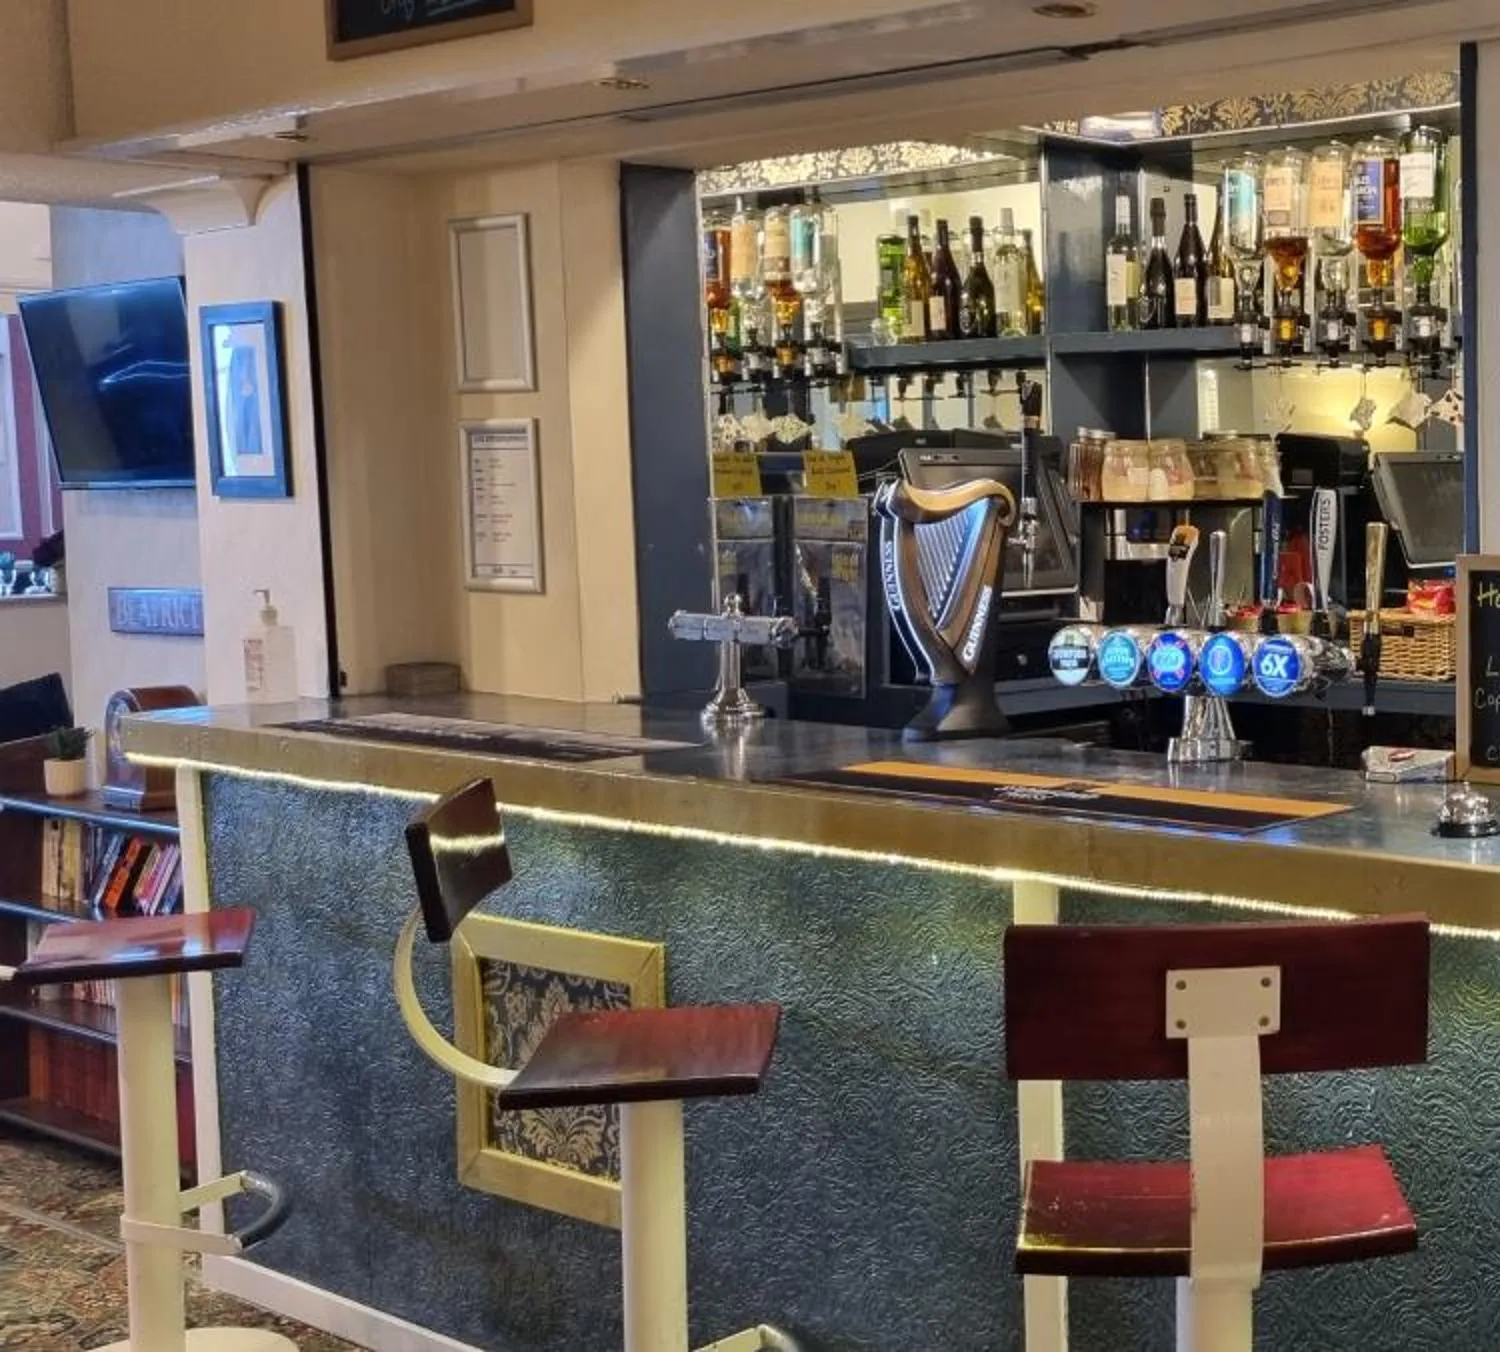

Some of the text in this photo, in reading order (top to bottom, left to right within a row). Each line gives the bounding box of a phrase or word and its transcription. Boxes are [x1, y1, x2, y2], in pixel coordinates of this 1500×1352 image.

[883, 540, 902, 611] GUINNESS
[963, 584, 994, 662] GUINNESS
[1260, 653, 1289, 679] 6X
